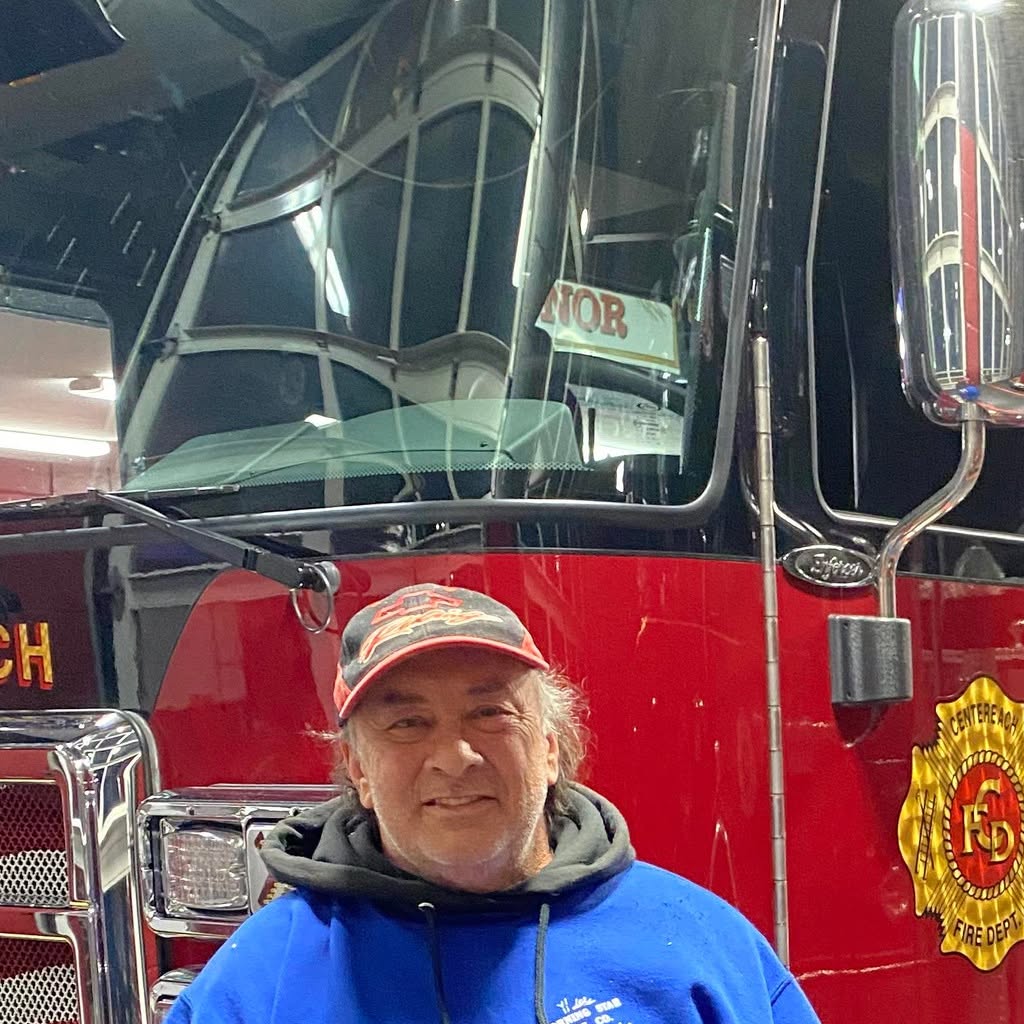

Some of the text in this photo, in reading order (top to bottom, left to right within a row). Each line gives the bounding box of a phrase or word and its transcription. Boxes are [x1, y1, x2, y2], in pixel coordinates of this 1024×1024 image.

[949, 702, 1019, 737] CENTEREACH
[952, 911, 1022, 947] FIRE DEPT.
[594, 997, 622, 1013] STAR
